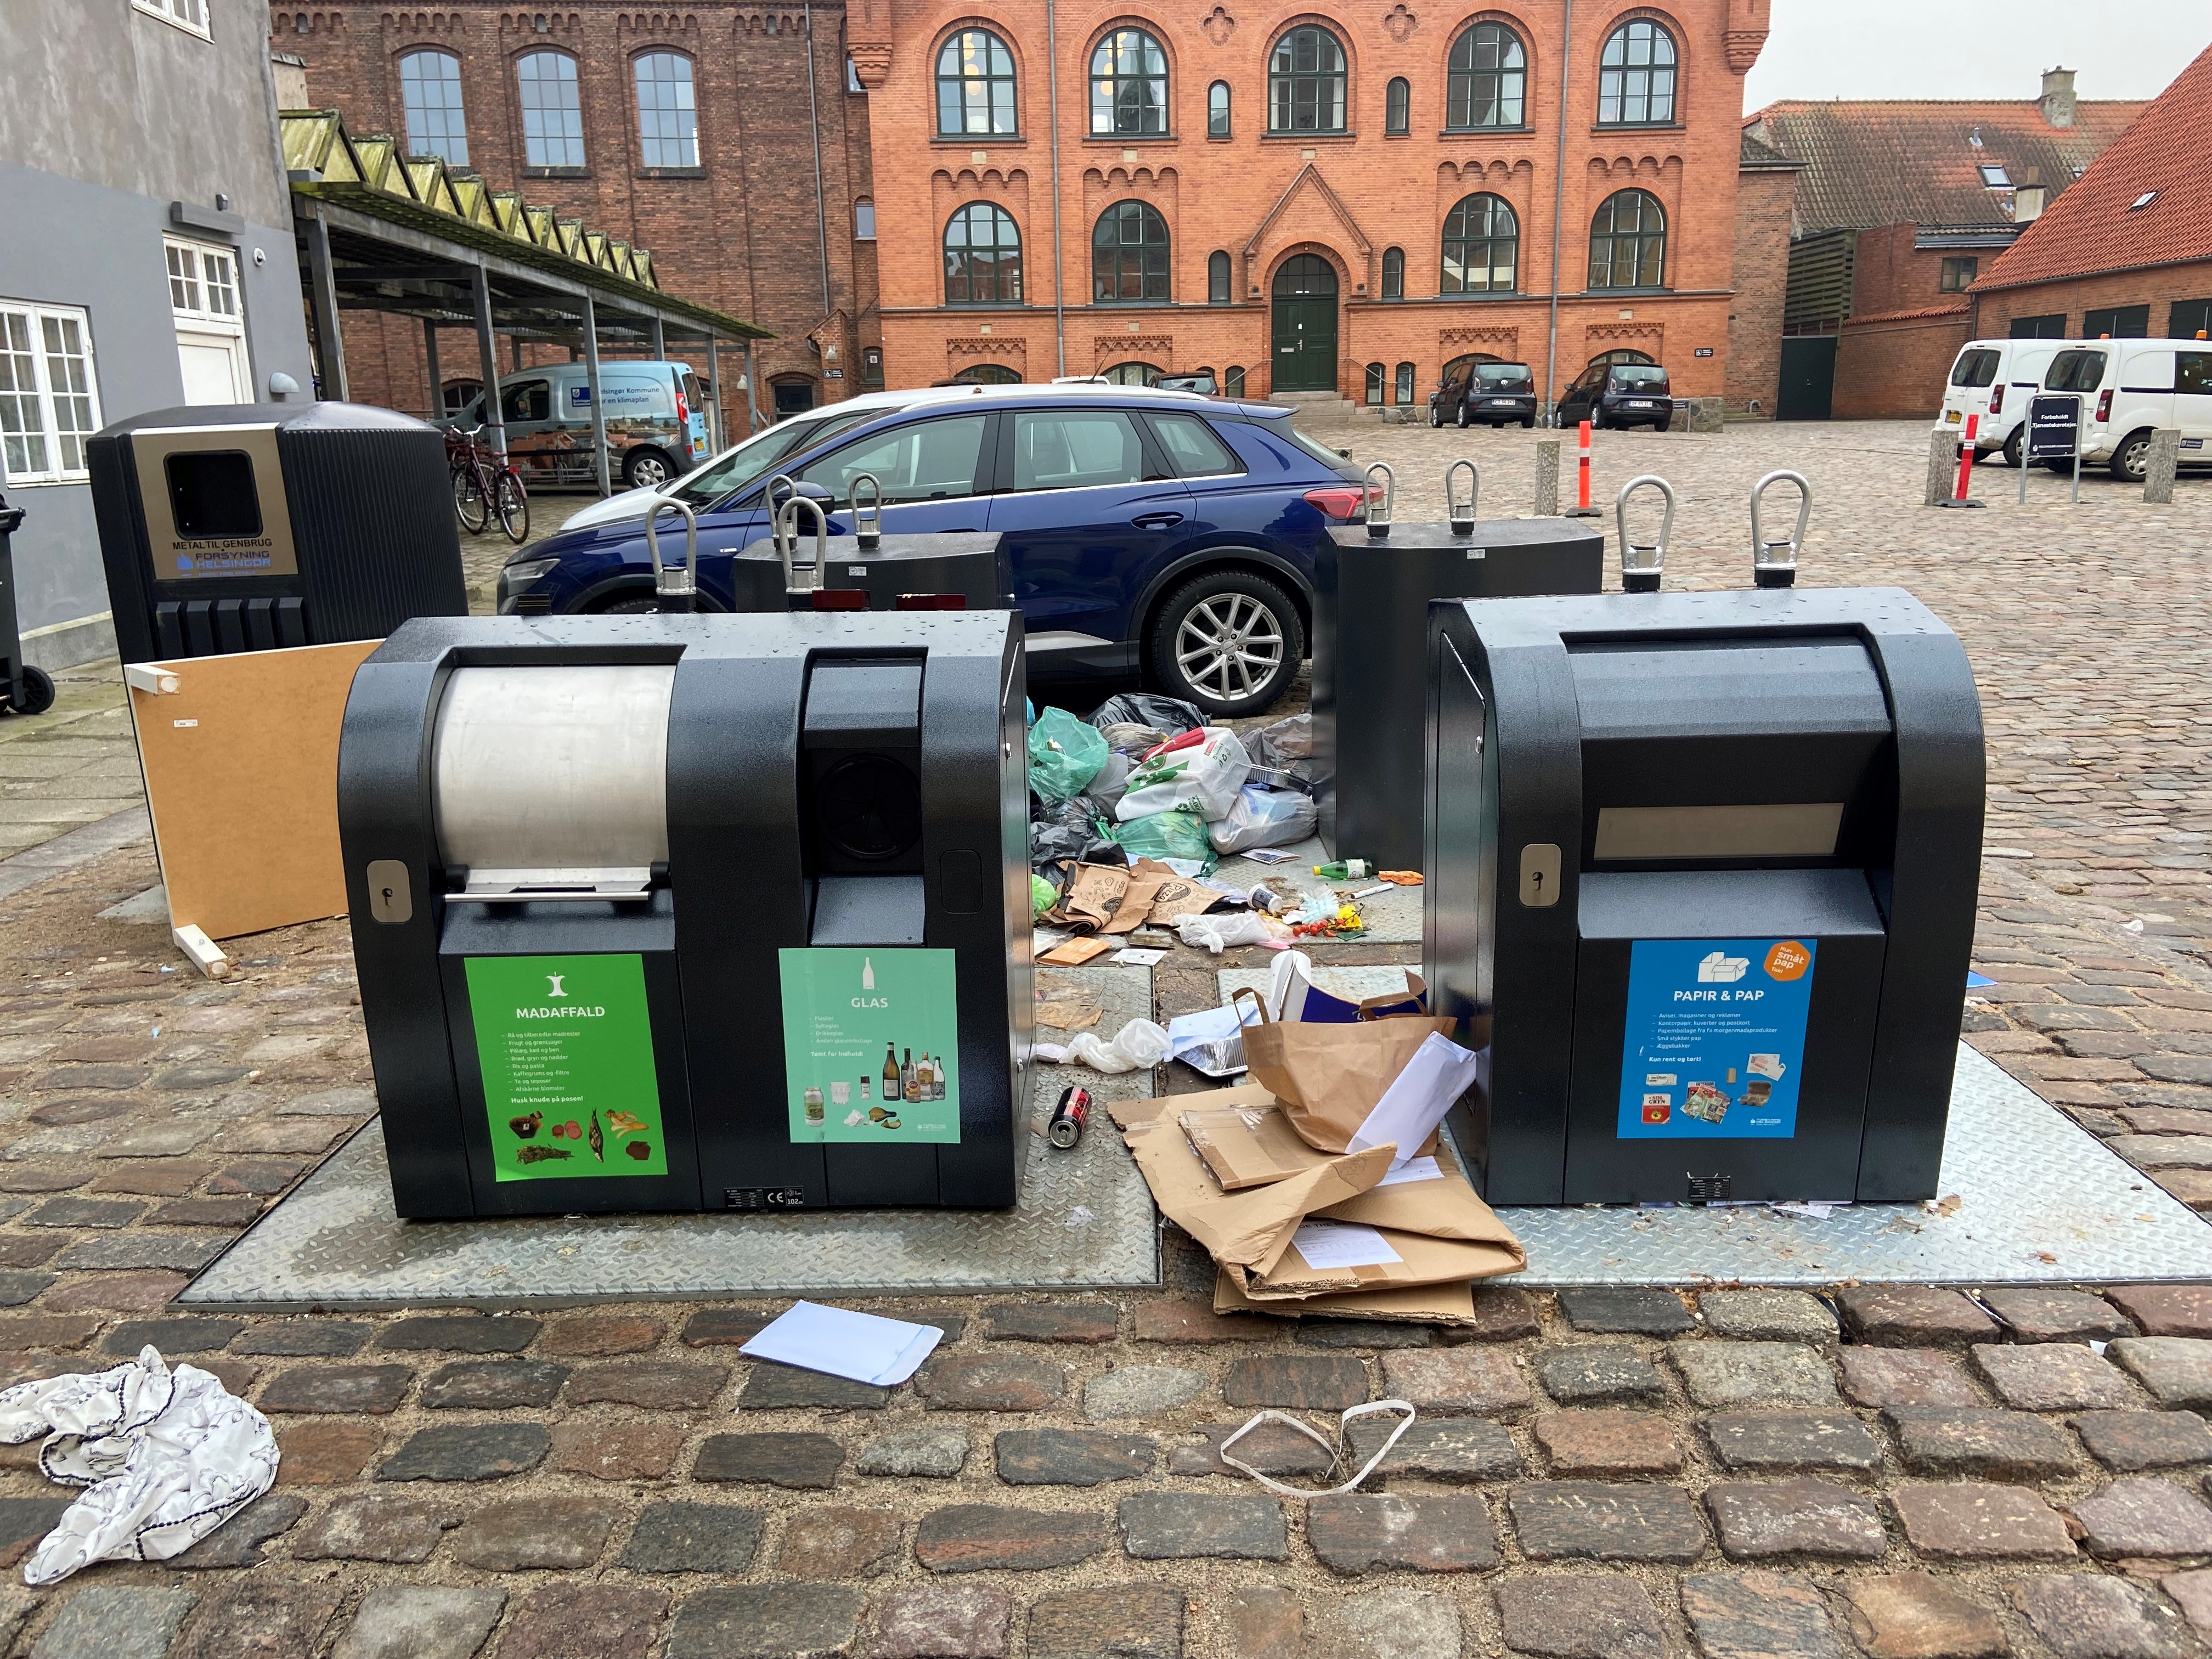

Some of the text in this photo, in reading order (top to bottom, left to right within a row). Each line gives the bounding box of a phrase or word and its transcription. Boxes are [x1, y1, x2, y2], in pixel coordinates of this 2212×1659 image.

[172, 541, 205, 550] METAL
[223, 539, 273, 548] GENBRUG
[195, 550, 270, 560] FORSYNING
[1773, 958, 1794, 969] pap
[1777, 952, 1805, 964] småt
[1674, 990, 1765, 1001] PAPIR & PAP
[851, 997, 888, 1008] GLAS
[516, 1006, 605, 1019] MADAFFALD
